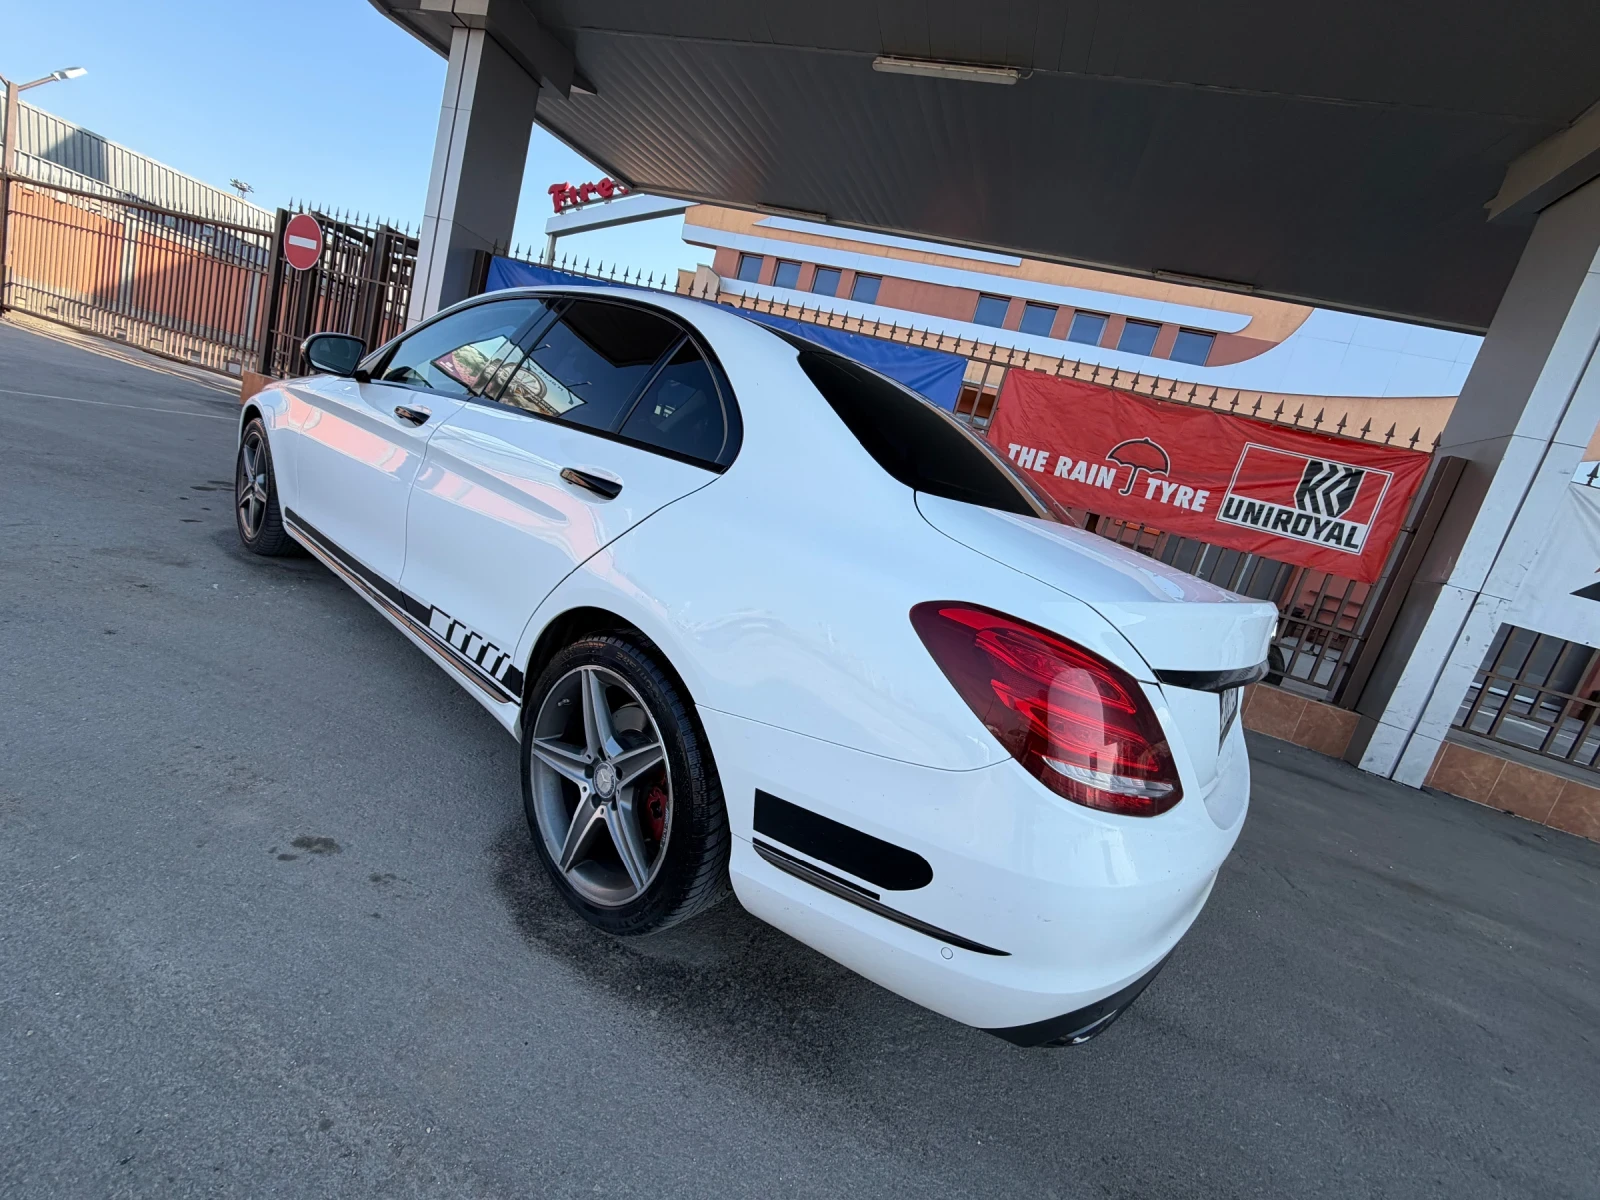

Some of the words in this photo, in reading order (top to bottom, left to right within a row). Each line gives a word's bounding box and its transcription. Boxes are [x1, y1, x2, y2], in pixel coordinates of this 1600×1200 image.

[1008, 442, 1050, 473] THE
[1053, 455, 1117, 490] RAIN
[1144, 477, 1210, 513] TYRE
[1222, 496, 1361, 550] UNIROYAL
